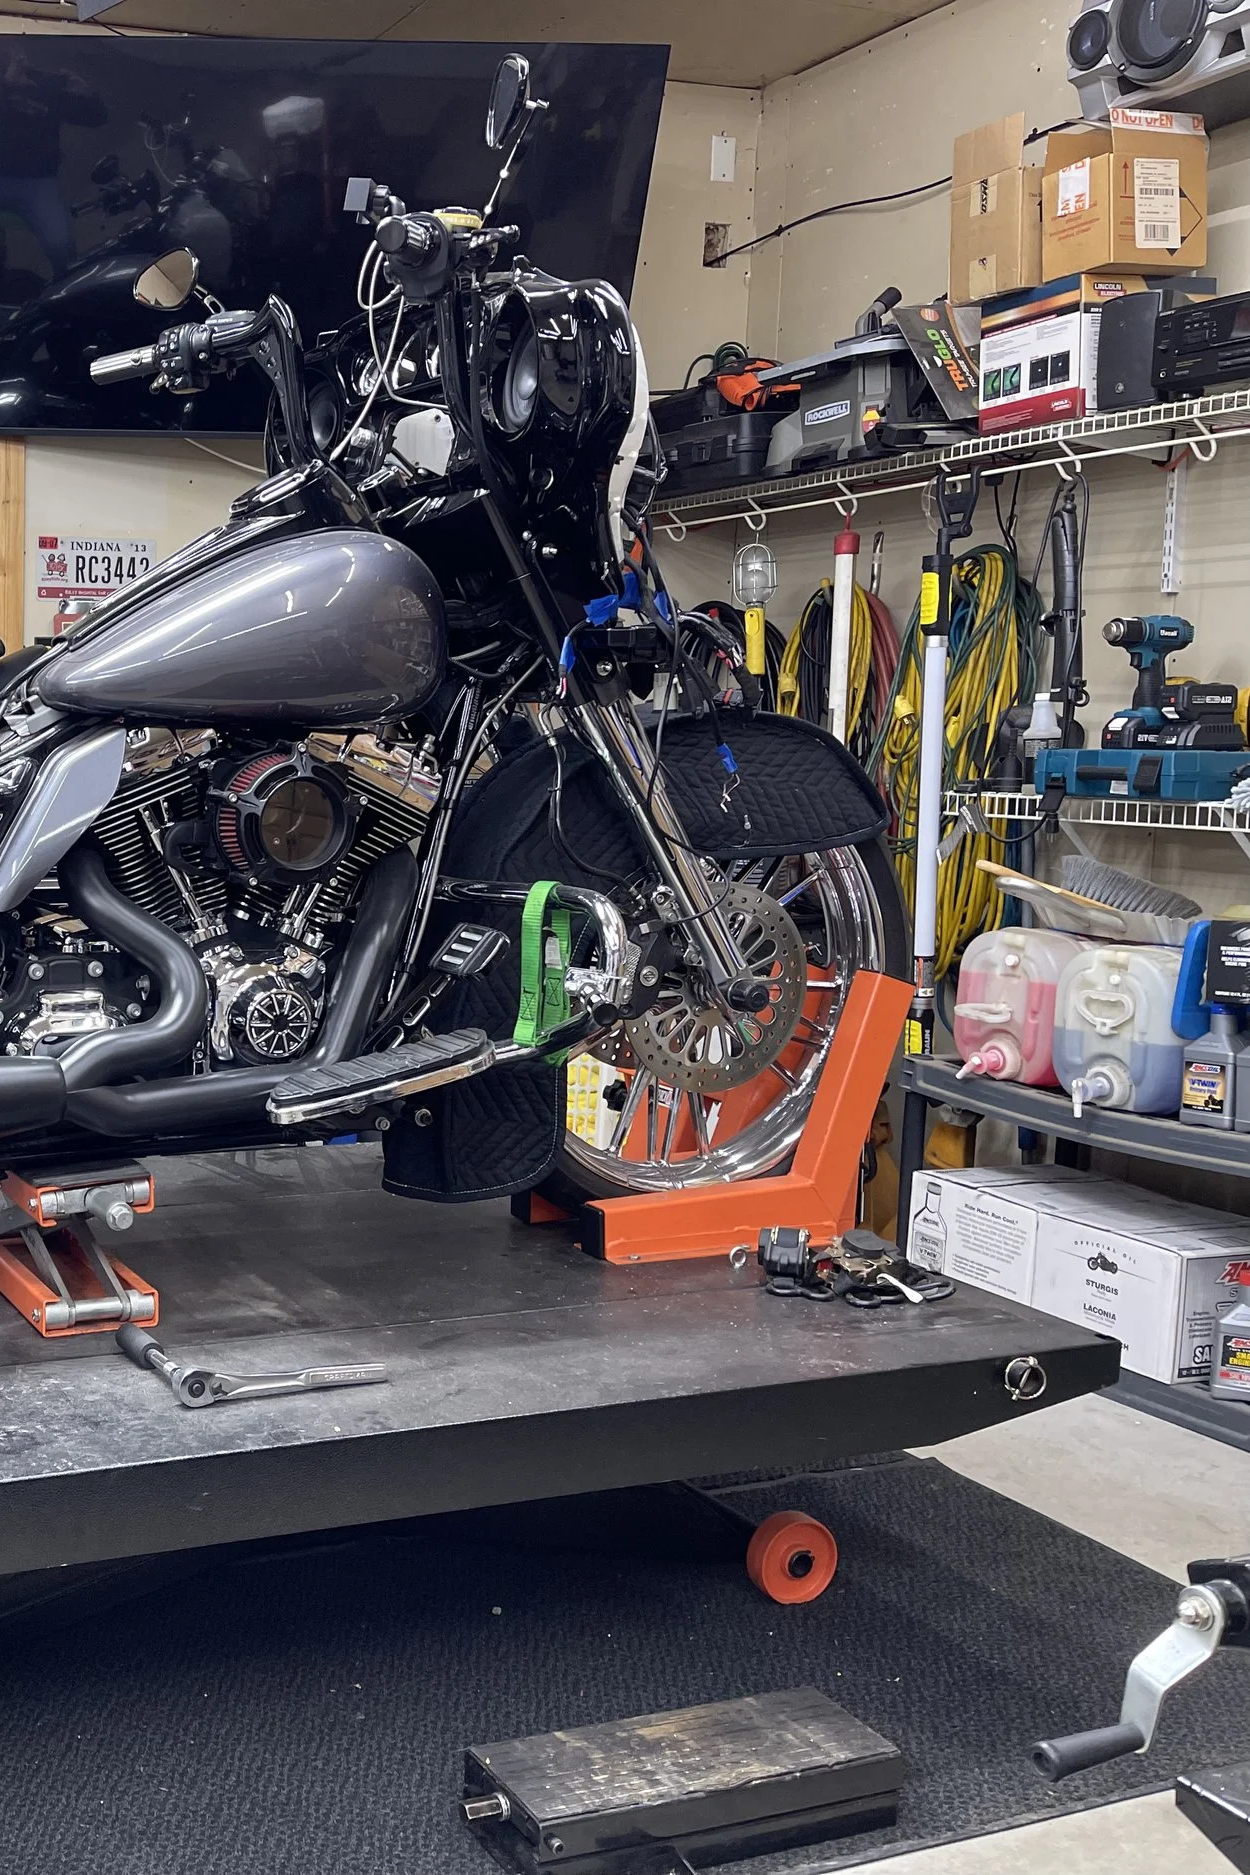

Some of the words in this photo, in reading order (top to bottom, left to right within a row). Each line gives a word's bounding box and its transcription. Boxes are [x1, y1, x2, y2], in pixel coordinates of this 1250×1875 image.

[807, 404, 847, 422] ROCKWELL
[70, 541, 121, 552] INDIANA
[1074, 1240, 1117, 1253] OFFICIAL
[1122, 1253, 1137, 1264] OIL
[1085, 1279, 1119, 1296] STURGIS
[1083, 1302, 1117, 1321] LACONIA
